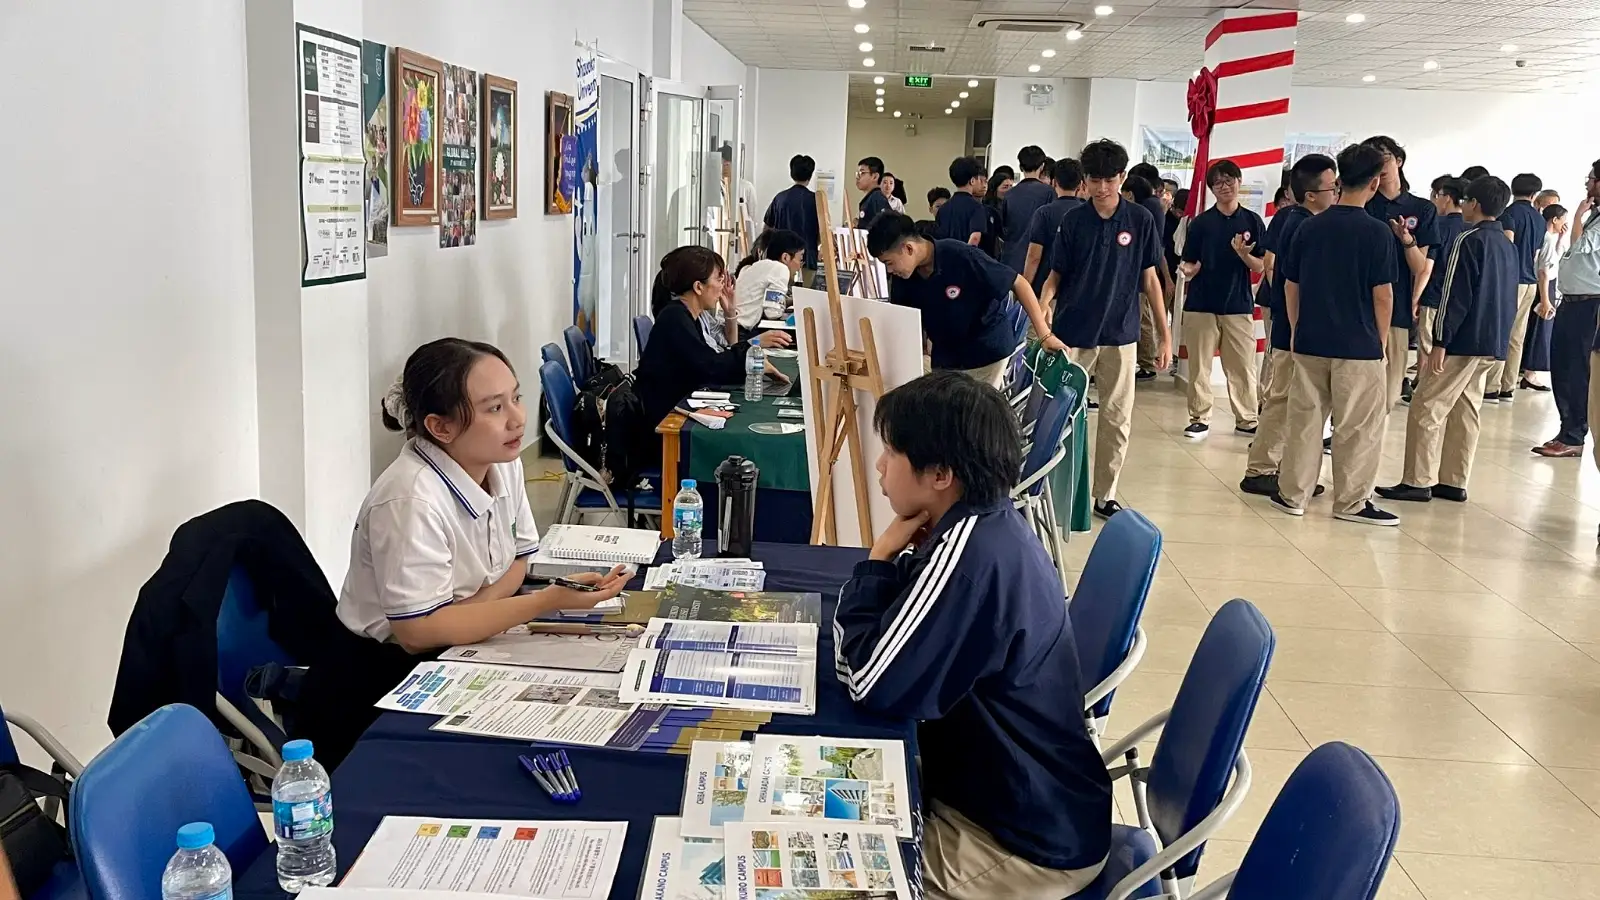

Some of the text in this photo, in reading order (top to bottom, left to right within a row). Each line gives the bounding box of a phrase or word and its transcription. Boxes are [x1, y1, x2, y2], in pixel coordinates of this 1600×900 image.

[696, 771, 708, 805] CHIBA CAMPUS
[654, 852, 671, 900] AKANO CAMPUS
[737, 855, 748, 900] KURO CAMPUS
